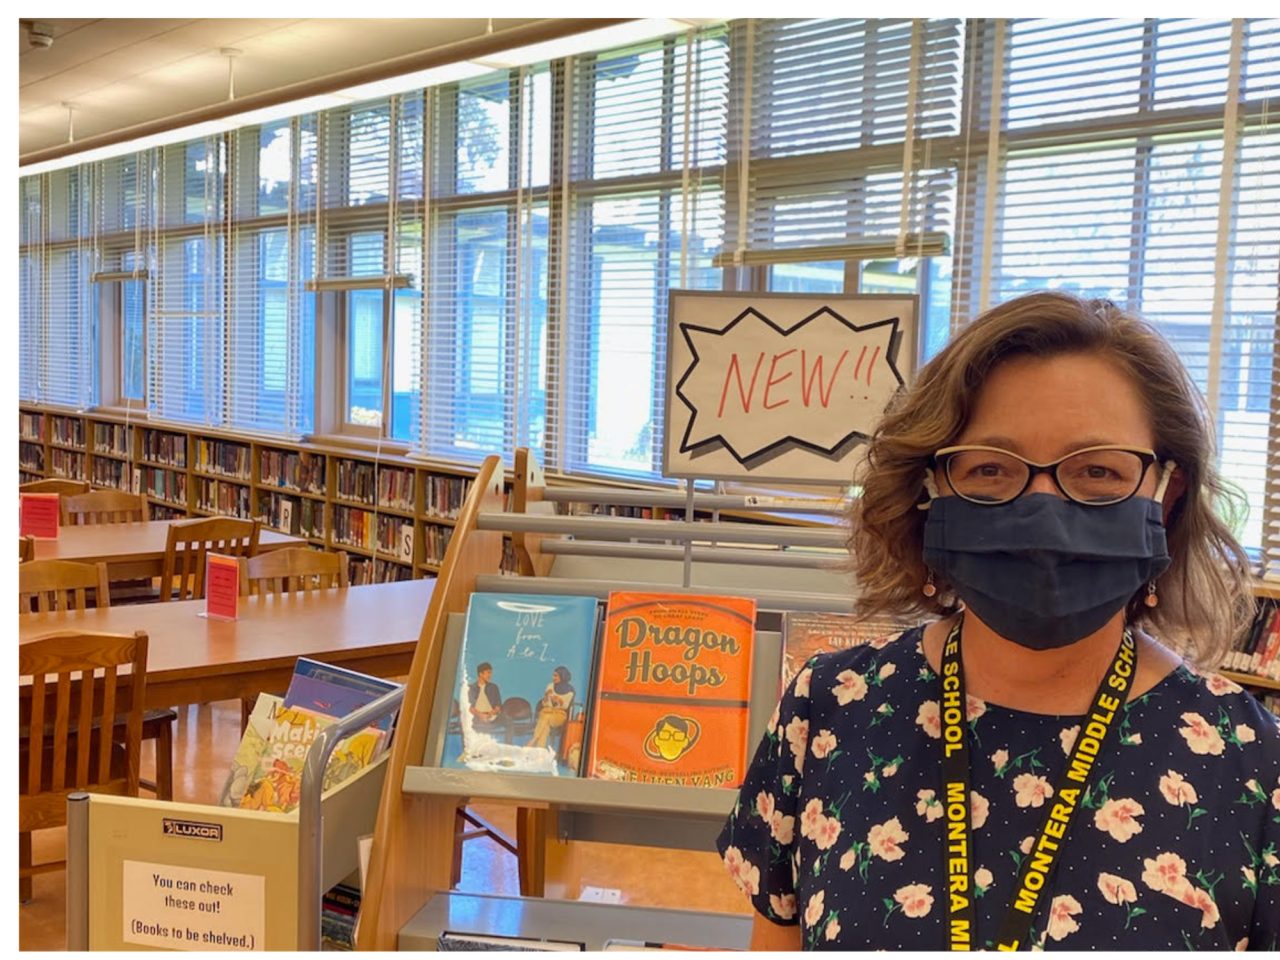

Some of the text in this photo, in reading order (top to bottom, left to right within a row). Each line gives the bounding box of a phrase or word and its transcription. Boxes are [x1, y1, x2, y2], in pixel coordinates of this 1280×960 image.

[717, 345, 881, 418] NEW!!
[403, 534, 411, 557] S
[516, 611, 544, 627] LOVE
[516, 627, 541, 646] from
[615, 616, 741, 661] Dragon
[625, 650, 726, 695] Hoops
[943, 661, 963, 758] SCHOOL
[1013, 627, 1135, 914] MONTERA MIDDLE SCHO
[175, 825, 219, 838] LUXOR
[946, 782, 969, 913] MONTERA
[152, 874, 234, 896] You can check
[165, 896, 221, 914] these out!
[131, 918, 255, 950] (Books to be shelved.)
